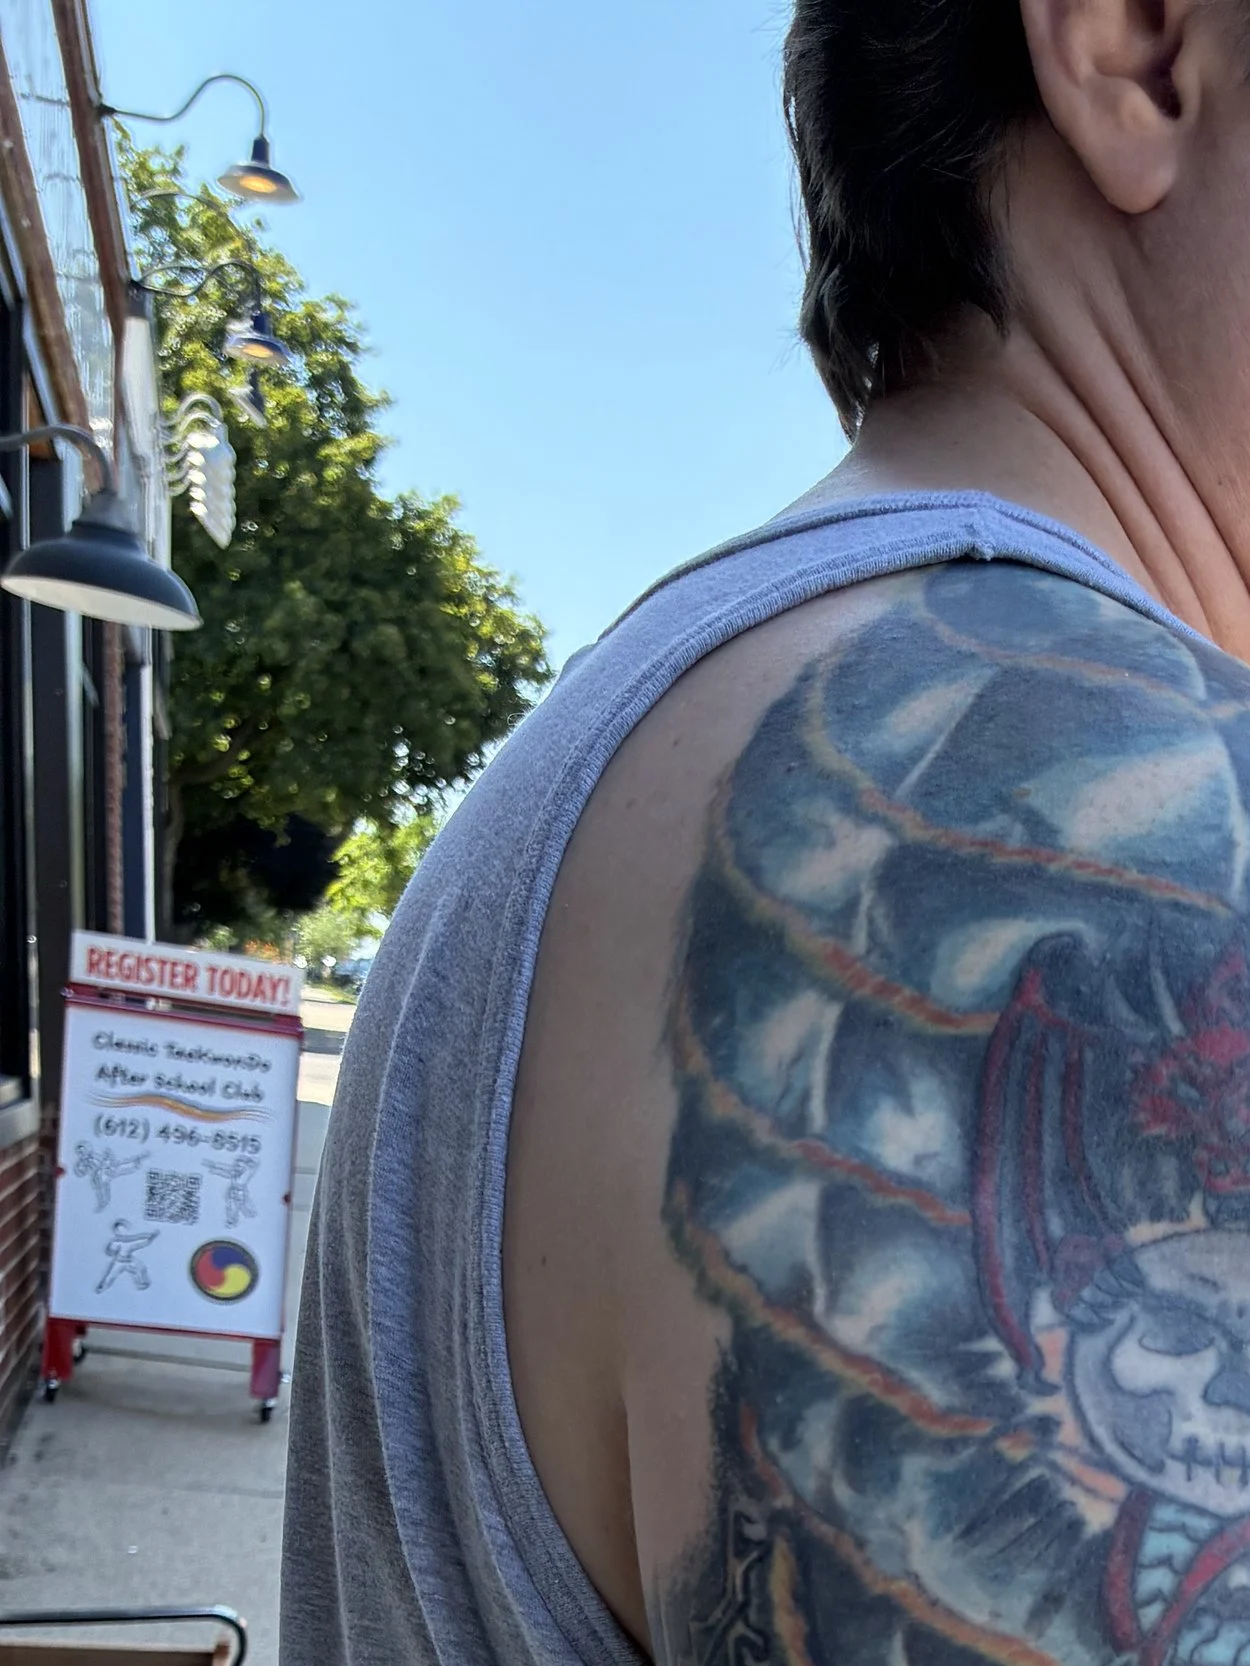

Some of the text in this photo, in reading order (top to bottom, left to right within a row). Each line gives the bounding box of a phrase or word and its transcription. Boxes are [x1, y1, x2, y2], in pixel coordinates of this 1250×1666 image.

[87, 945, 291, 1007] REGISTER TODAY!
[93, 1031, 158, 1058] Classic
[96, 1063, 265, 1103] After School Club
[94, 1114, 150, 1144] (612)
